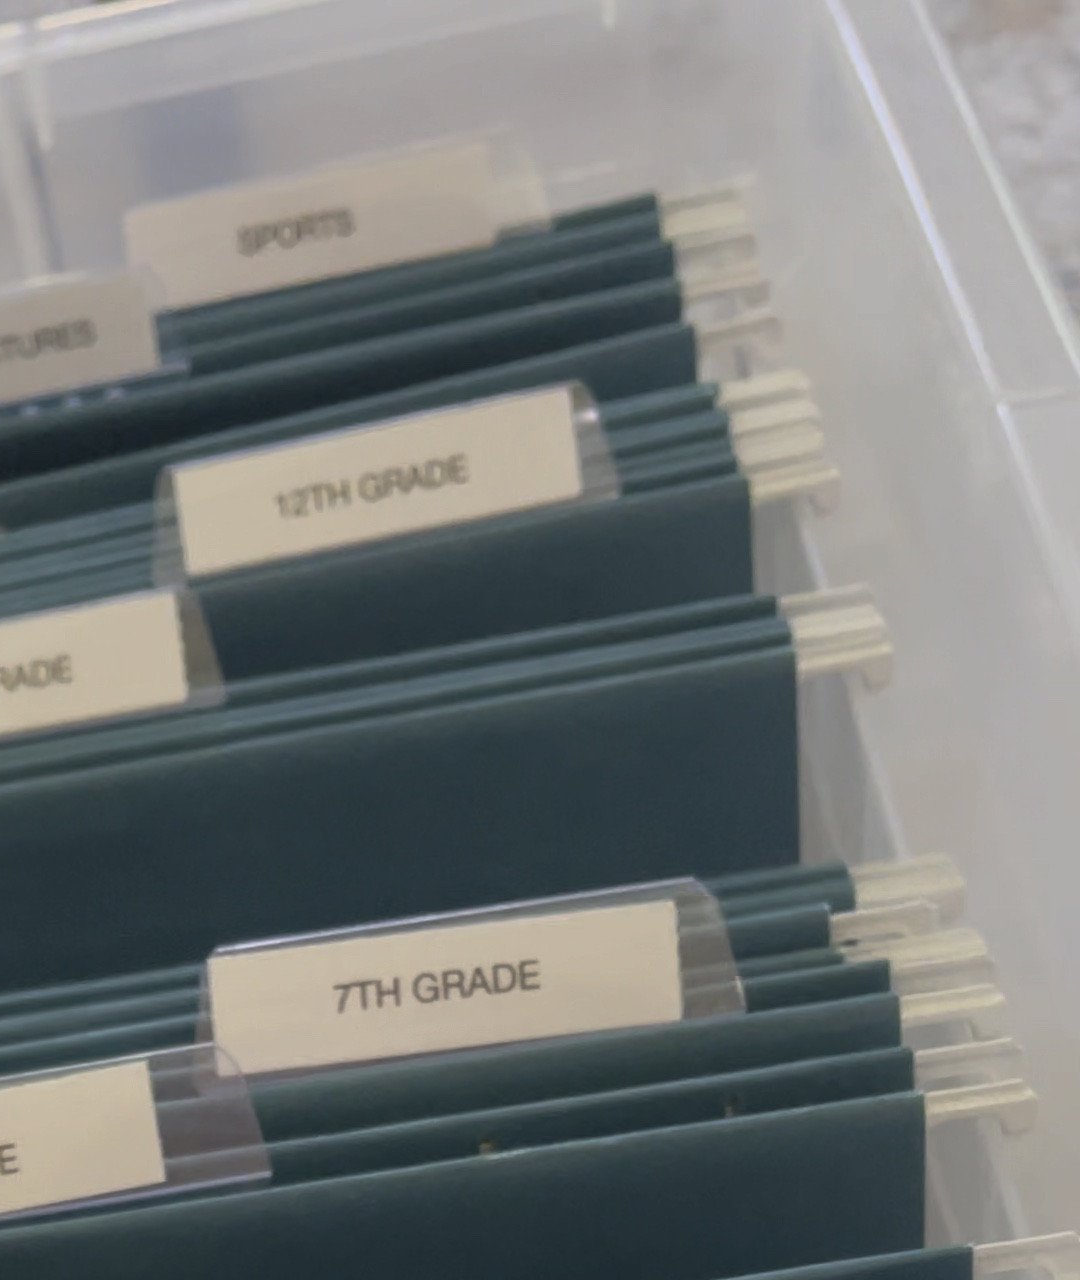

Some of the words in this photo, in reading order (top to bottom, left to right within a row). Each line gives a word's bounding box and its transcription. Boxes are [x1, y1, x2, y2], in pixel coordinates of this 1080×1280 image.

[237, 208, 356, 257] SPORTS
[273, 479, 352, 519] 12TH
[358, 453, 469, 503] GRADE
[332, 976, 402, 1014] 7TH
[412, 959, 541, 1004] GRADE
